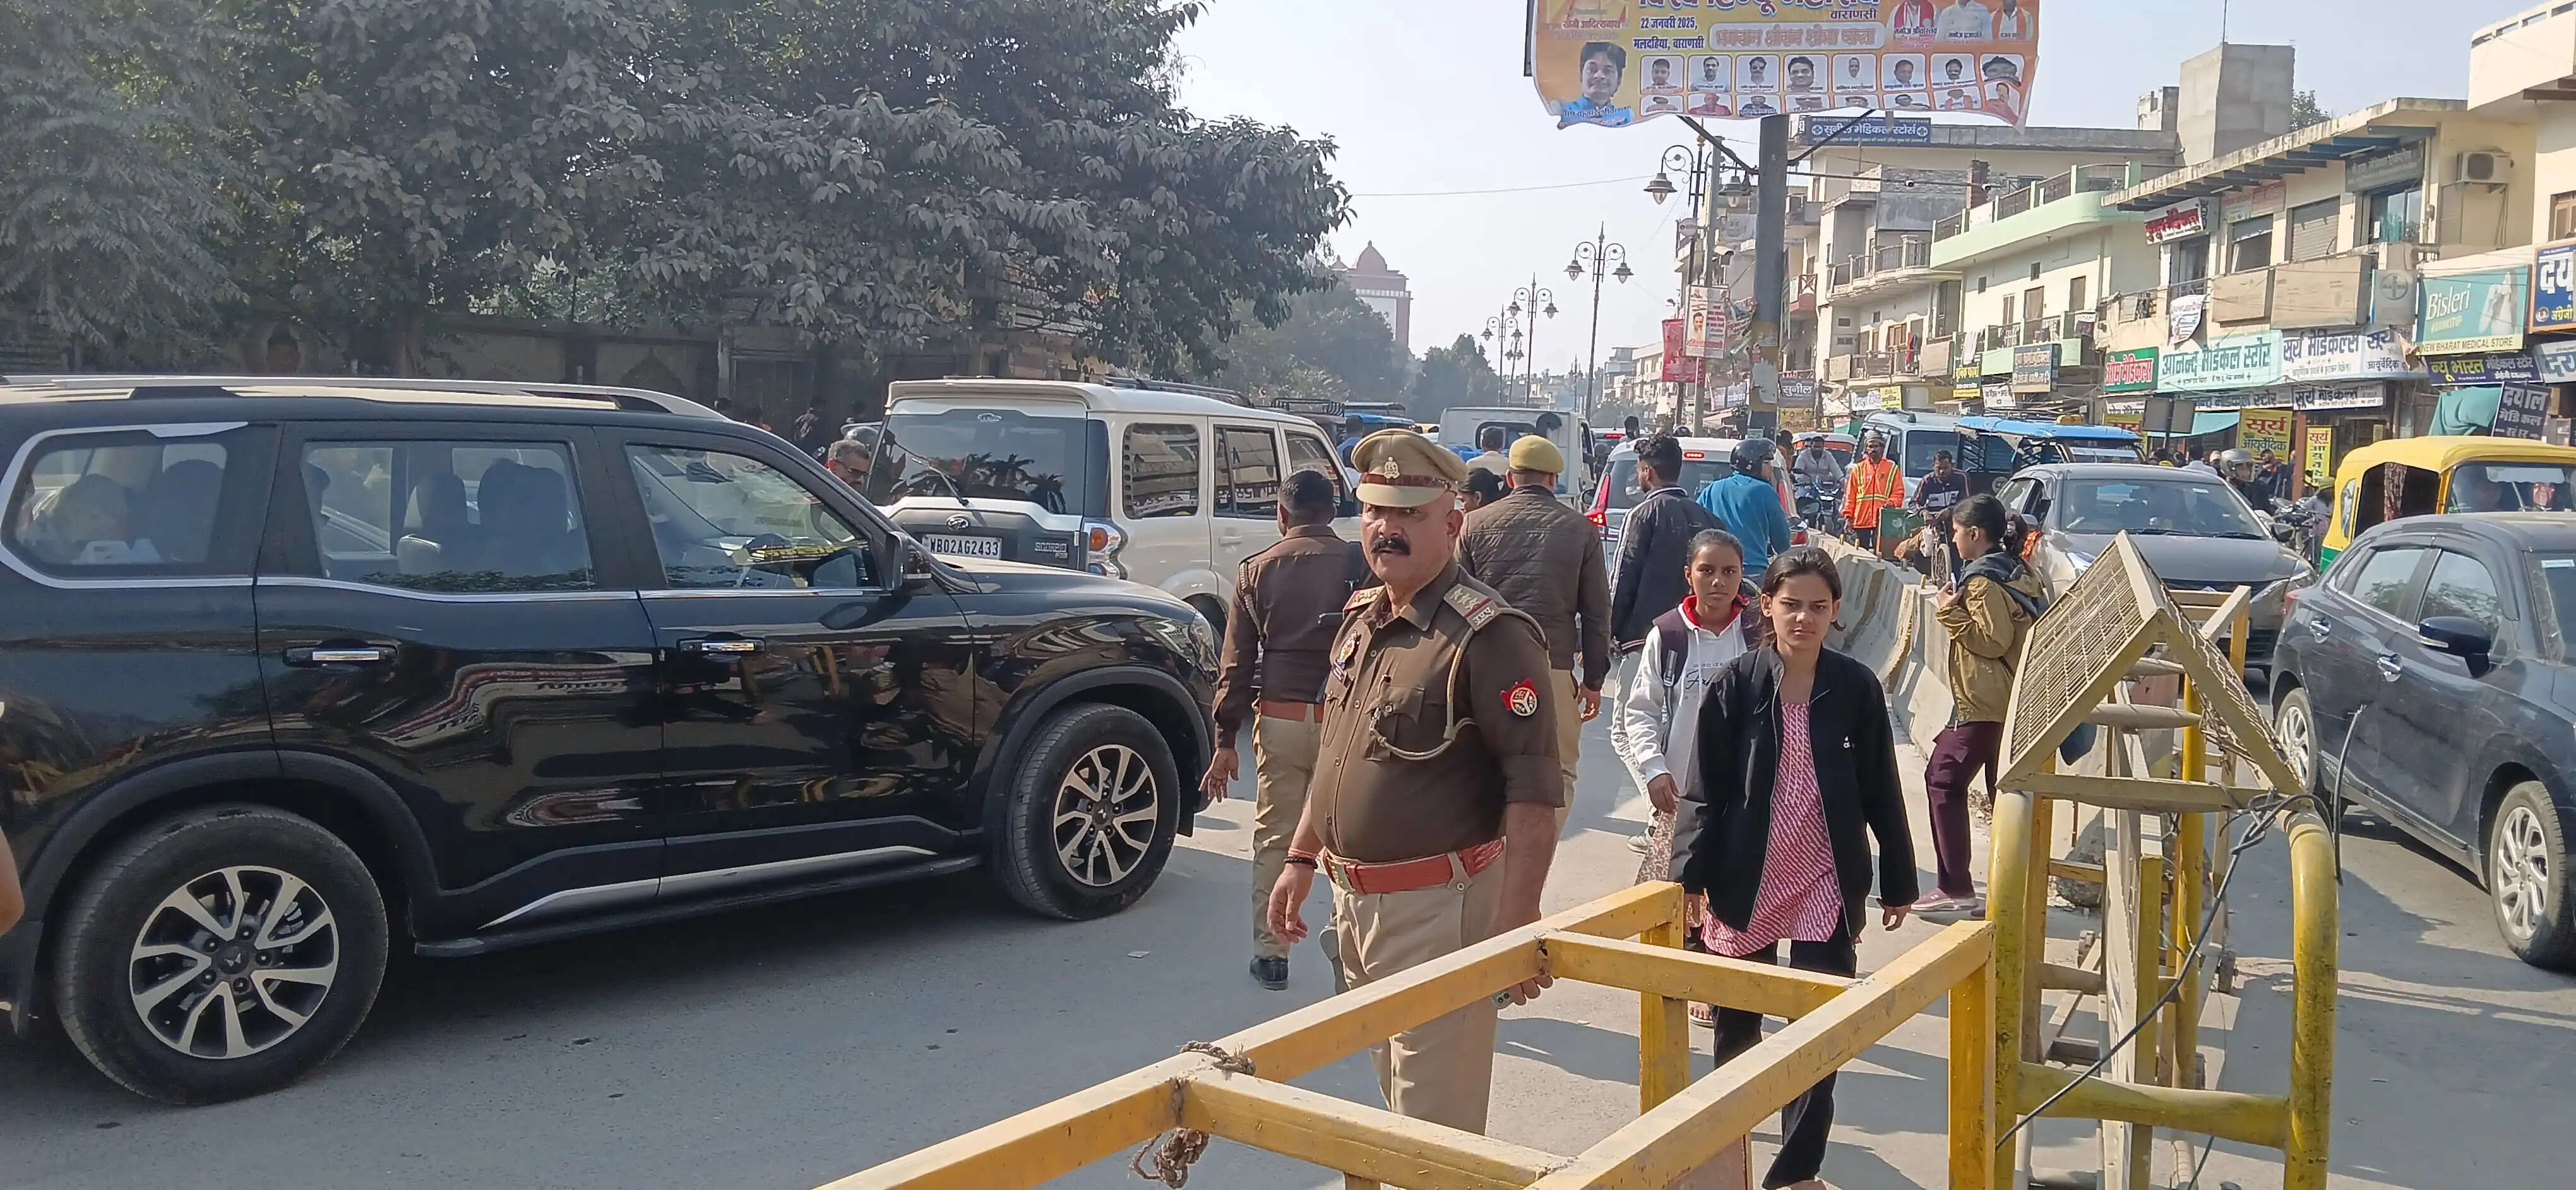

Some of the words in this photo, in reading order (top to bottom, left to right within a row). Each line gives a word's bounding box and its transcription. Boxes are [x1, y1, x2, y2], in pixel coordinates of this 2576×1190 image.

[1830, 8, 1877, 20] वाराणसी
[1641, 18, 1650, 29] 22
[1651, 16, 1675, 29] जनवरी
[1678, 16, 1698, 30] 2025,
[1633, 37, 1671, 50] मलदहिया,
[1673, 36, 1705, 49] वाराणसी
[1892, 123, 1917, 135] स्टोर्स
[2425, 282, 2471, 321] Bisleri
[2283, 331, 2304, 363] सूर्य
[2436, 342, 2461, 351] BHARAT
[2462, 339, 2490, 349] MEDICAL
[2491, 337, 2513, 347] STORE
[2244, 337, 2272, 368] स्टोर
[2450, 358, 2485, 374] भारत
[1783, 382, 1813, 396] सुनील
[2501, 386, 2548, 411] दयाल
[2245, 416, 2287, 436] सूर्य
[2241, 436, 2287, 453] आयुर्वेदिक
[2308, 430, 2329, 444] सूर्य
[930, 538, 999, 556] WB02AG2433
